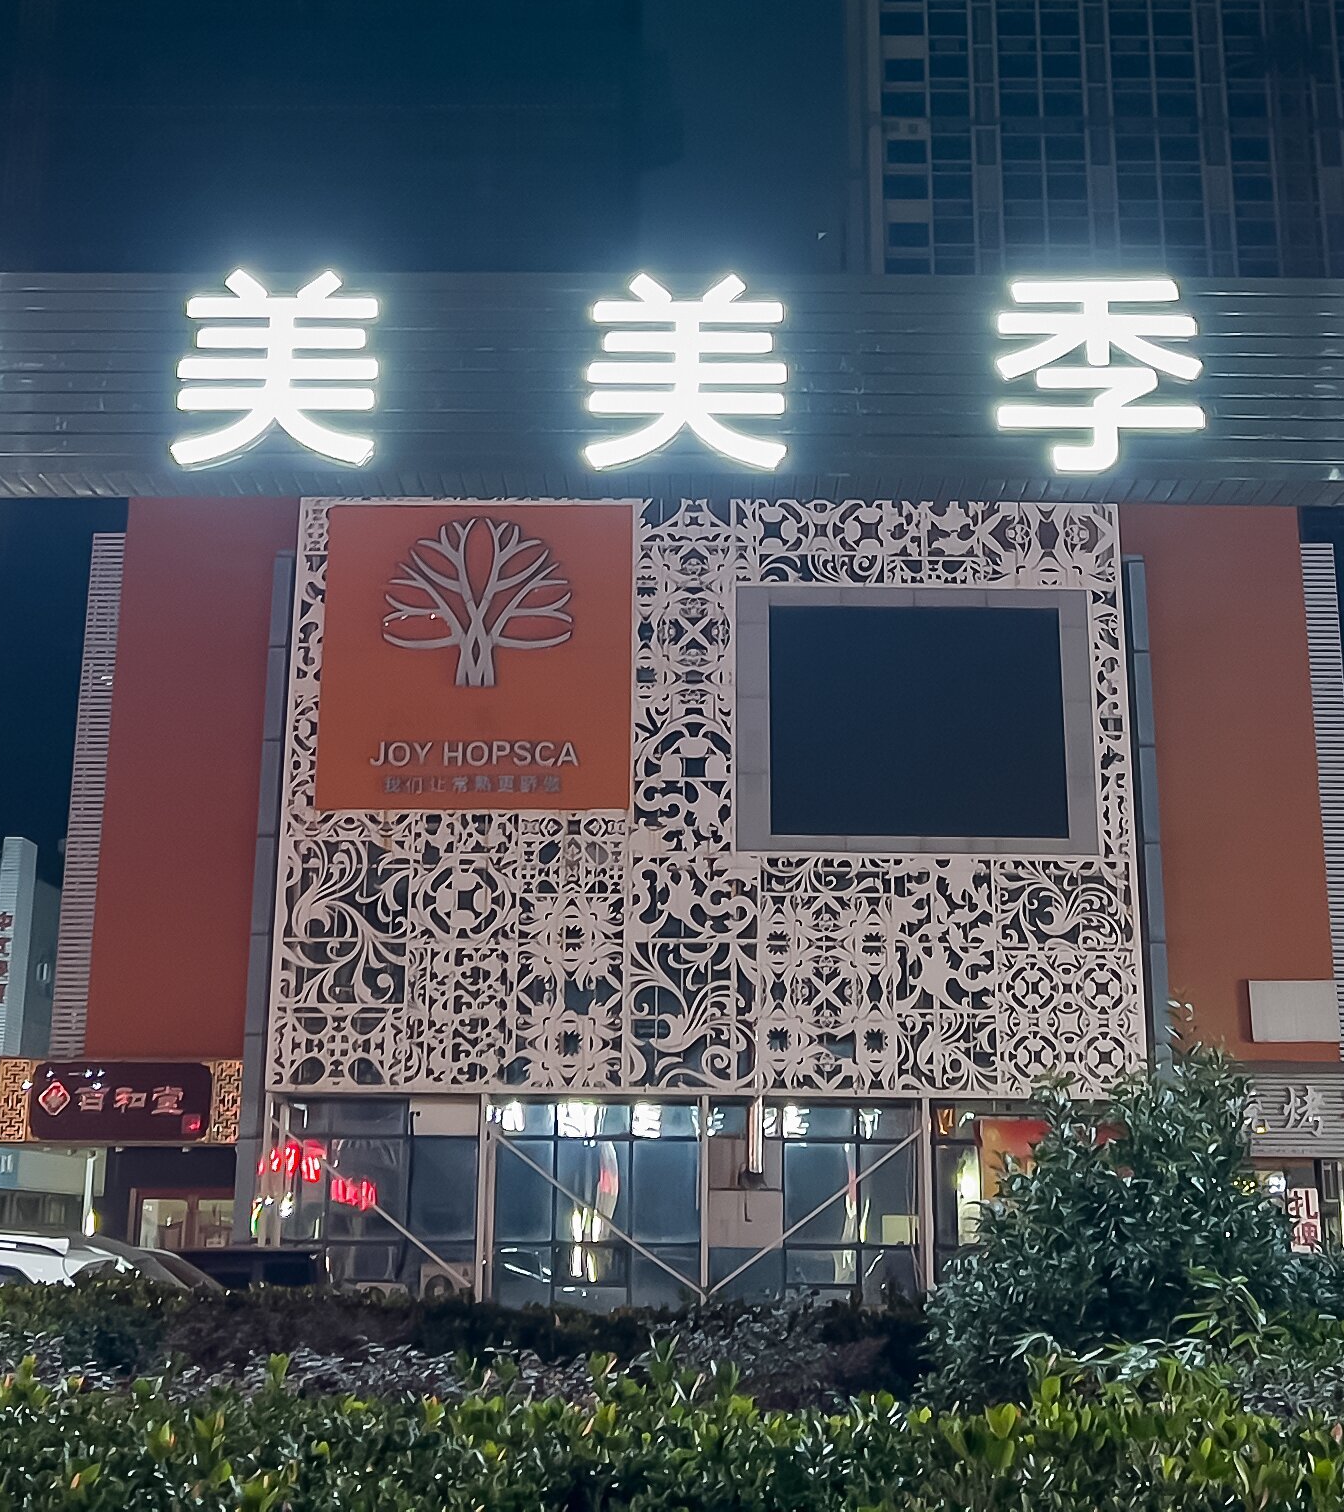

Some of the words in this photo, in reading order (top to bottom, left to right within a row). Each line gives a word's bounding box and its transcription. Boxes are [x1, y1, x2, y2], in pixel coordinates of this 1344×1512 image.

[369, 740, 433, 767] JOY
[443, 740, 579, 767] HOPSCA
[74, 1084, 185, 1116] 百和堂
